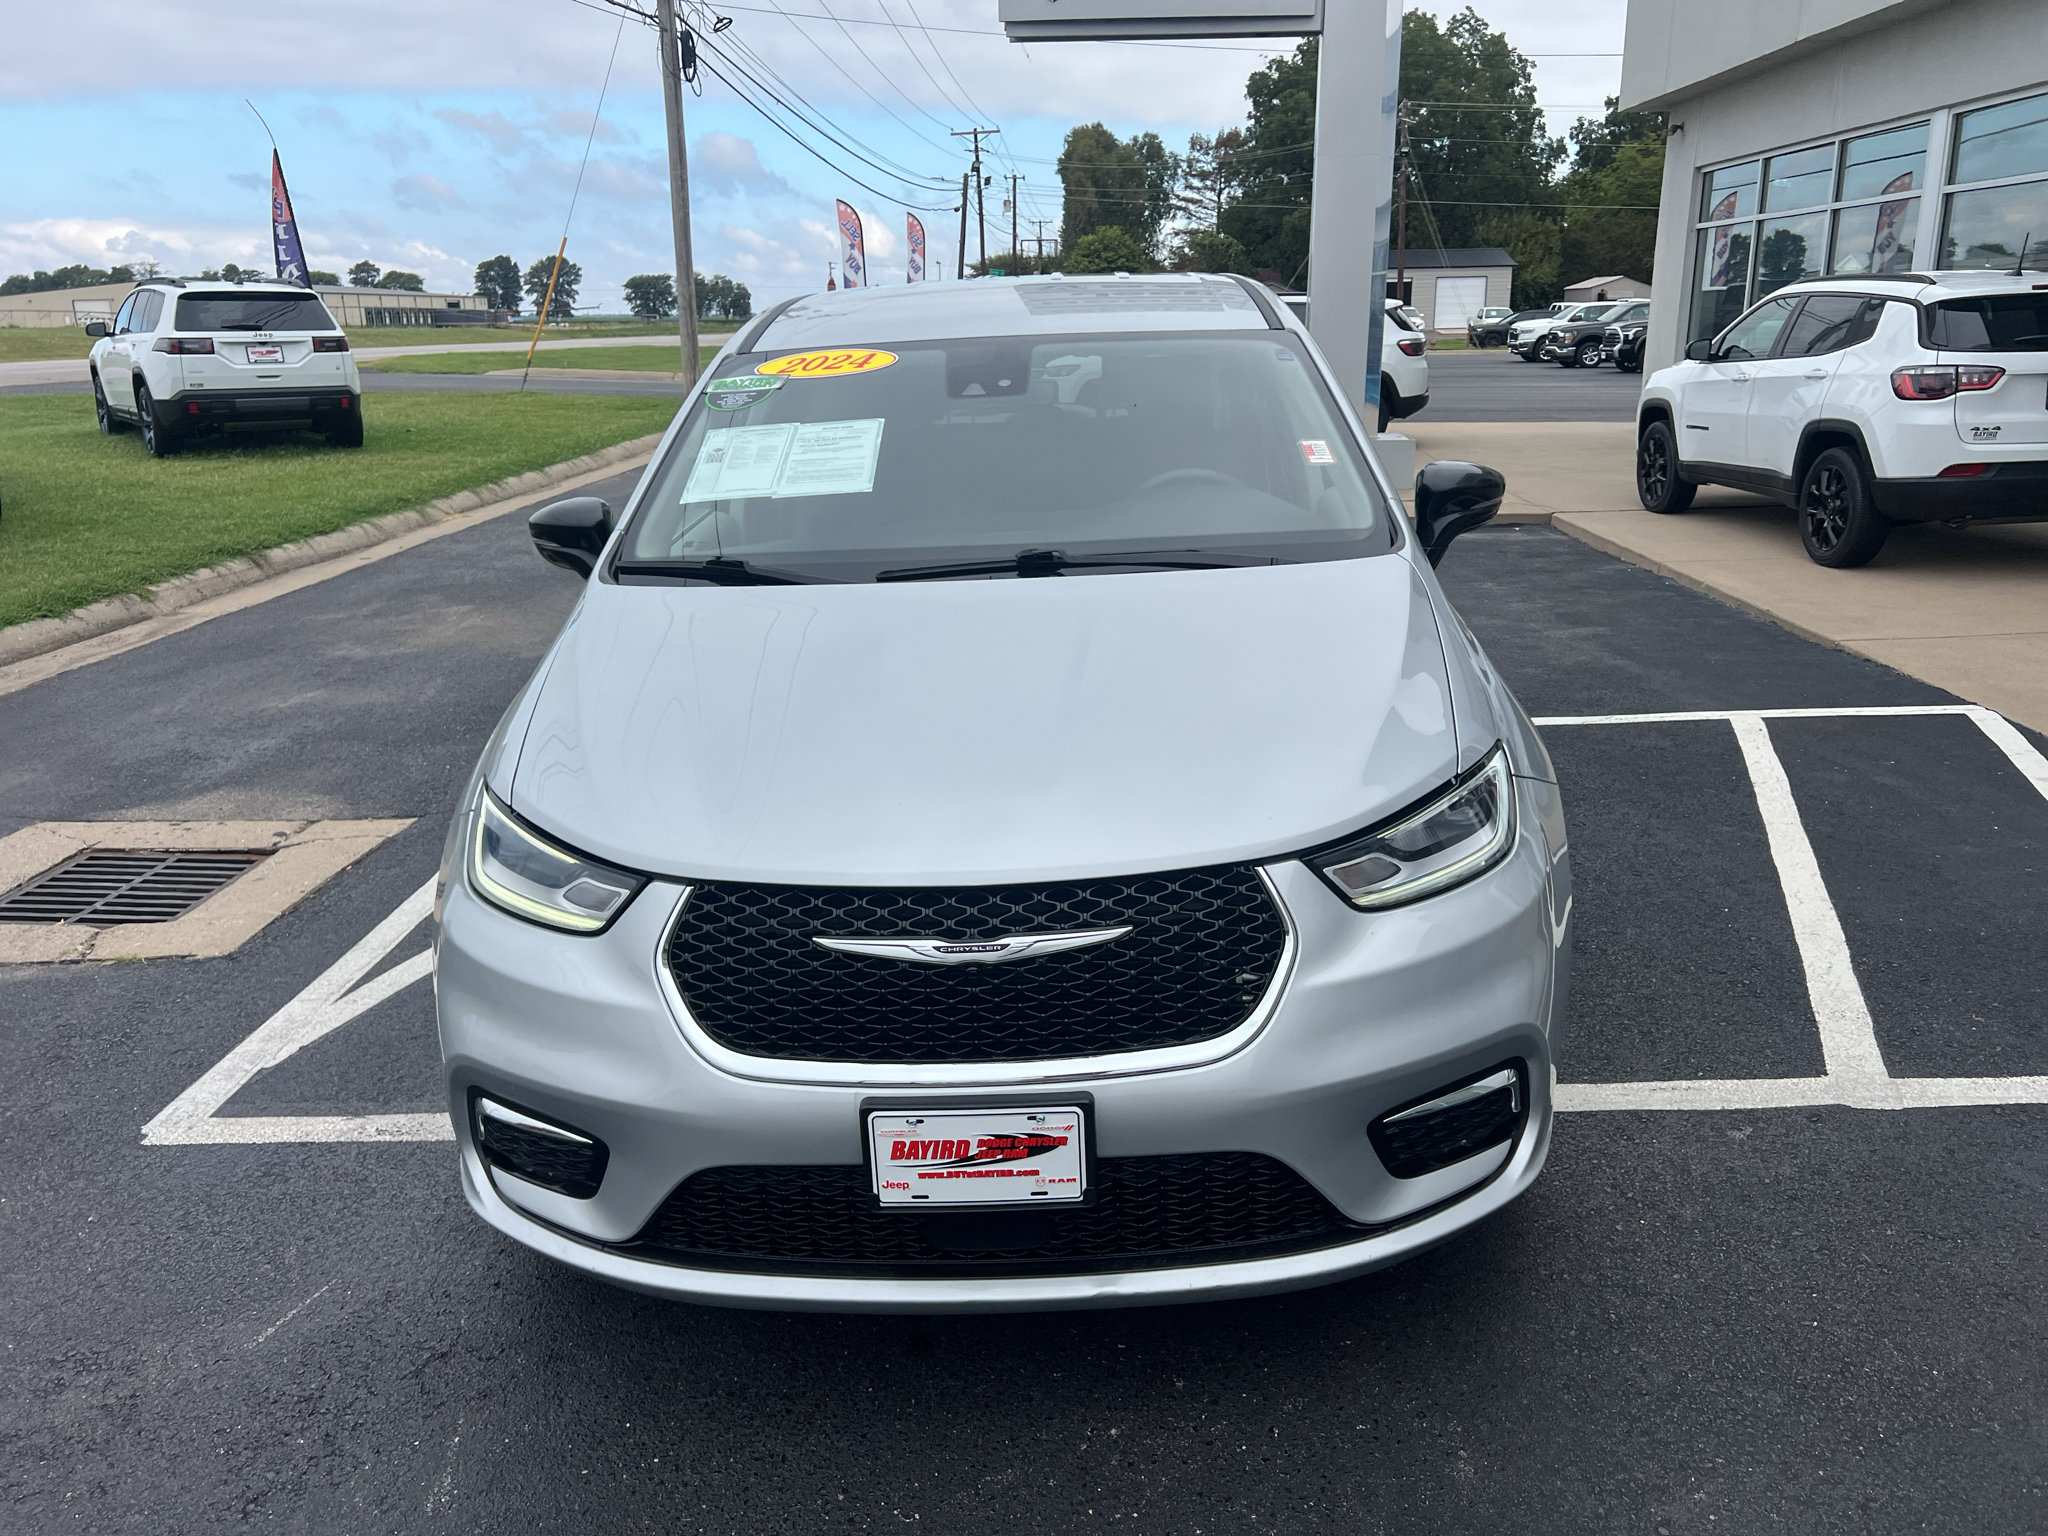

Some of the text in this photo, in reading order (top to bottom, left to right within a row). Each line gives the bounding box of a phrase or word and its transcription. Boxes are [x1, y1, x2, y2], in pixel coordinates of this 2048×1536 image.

[776, 353, 877, 374] 2024
[977, 1136, 1068, 1148] DODGE CHRYSLER
[890, 1140, 970, 1160] BAYIRD
[974, 1148, 1028, 1159] JEEP RAM
[881, 1180, 910, 1190] Jeep
